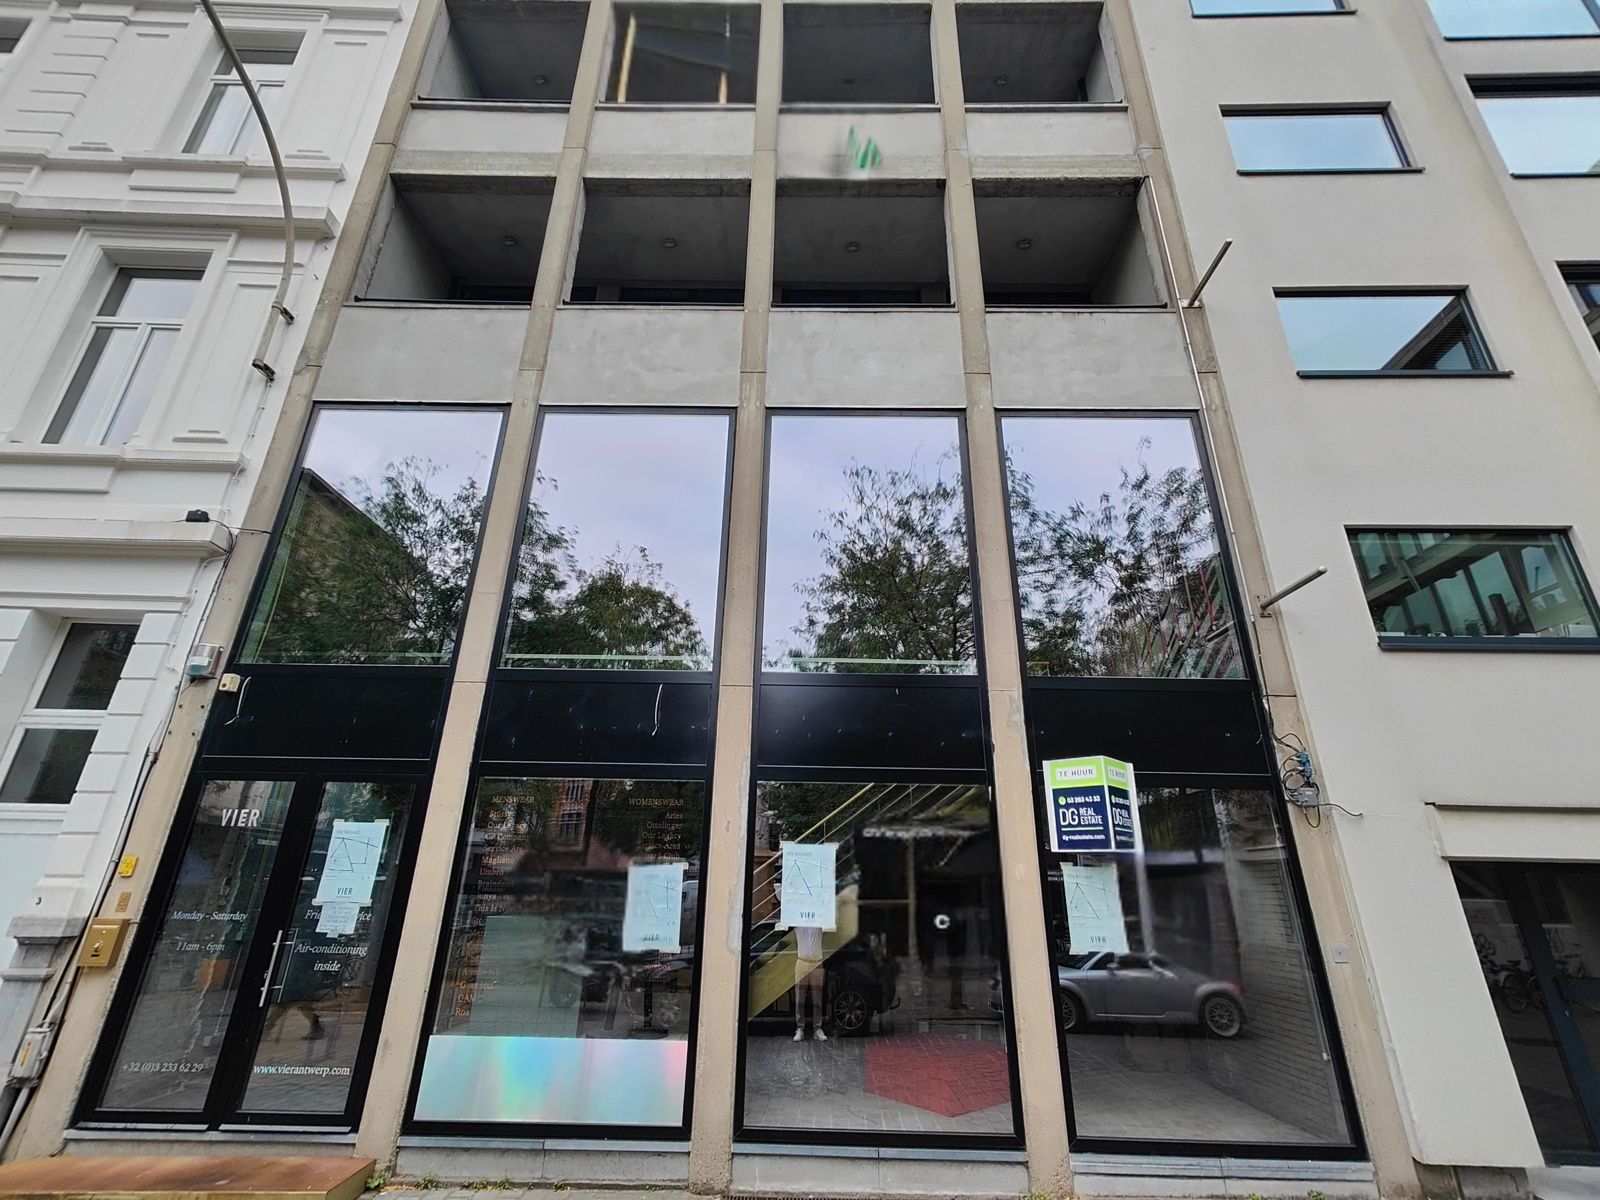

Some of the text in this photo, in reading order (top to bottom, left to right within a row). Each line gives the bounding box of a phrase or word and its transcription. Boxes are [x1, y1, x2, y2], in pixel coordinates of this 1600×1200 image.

[1072, 769, 1093, 777] HUUR
[490, 796, 535, 804] MENSWEAR
[629, 798, 684, 806] WOMENSWEAR
[1079, 807, 1096, 816] REAL
[221, 808, 260, 827] VIER
[1060, 808, 1079, 825] DG
[1081, 815, 1103, 825] ESTATE
[481, 856, 516, 865] Magliano
[480, 868, 504, 876] Umbro
[337, 888, 353, 896] VIER
[171, 911, 206, 922] Monday
[211, 911, 248, 922] Saturday
[800, 911, 816, 920] VIER
[1090, 936, 1107, 944] VIER
[176, 942, 200, 951] 11am
[206, 942, 225, 953] 6pm
[295, 943, 369, 957] Air-conditioning
[314, 961, 342, 971] inside
[141, 1062, 160, 1073] (0)3
[161, 1062, 178, 1072] 233
[179, 1062, 191, 1072] 62
[191, 1063, 204, 1073] 29
[253, 1064, 350, 1077] www.vierantwerp.com
